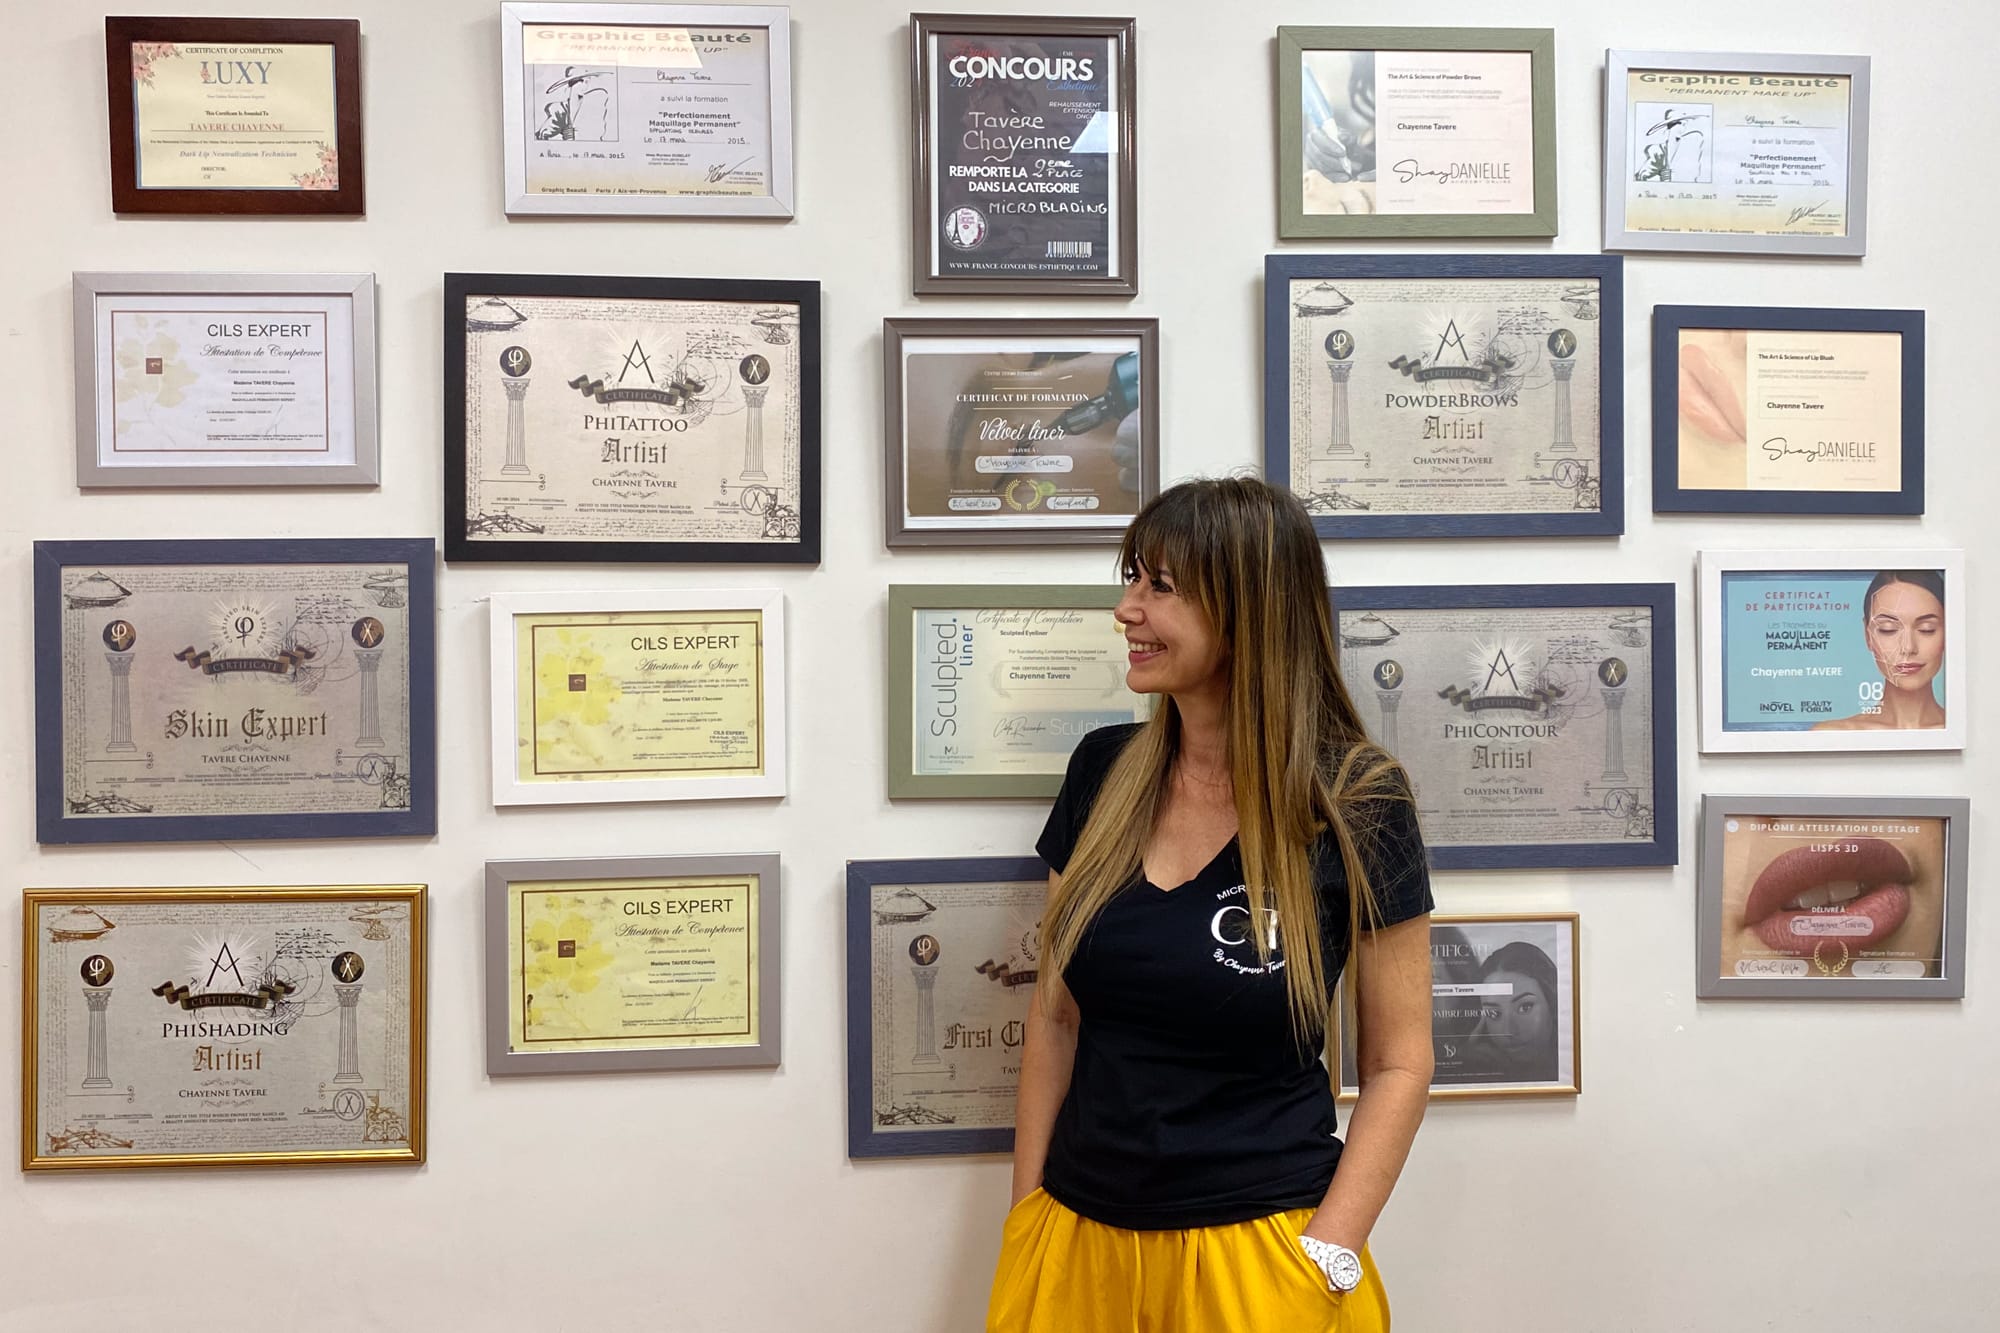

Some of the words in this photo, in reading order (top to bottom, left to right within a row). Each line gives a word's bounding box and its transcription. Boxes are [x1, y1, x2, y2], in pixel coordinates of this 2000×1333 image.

[536, 30, 645, 42] Graphic
[655, 33, 751, 43] Beauté
[201, 61, 272, 84] LUXY
[949, 56, 1094, 81] CONCOURS
[1639, 73, 1740, 86] Graphic
[1749, 74, 1839, 88] Beauté
[649, 120, 691, 128] Maquillage
[968, 108, 1045, 129] Tavère
[190, 123, 227, 131] TAVERE
[231, 123, 285, 131] CHAYENNE
[1397, 123, 1432, 131] Chayenne
[963, 130, 1073, 162] Chayenne
[949, 166, 1010, 178] REMPORTE
[1012, 166, 1027, 178] LA
[968, 181, 1000, 192] DANS
[1002, 182, 1017, 192] LA
[1018, 182, 1079, 193] CATEGORIE
[207, 324, 243, 337] CILS
[248, 324, 312, 337] EXPERT
[200, 344, 251, 356] Attestation
[254, 347, 264, 356] de
[604, 391, 671, 402] CERTIFICATE
[956, 394, 1014, 402] CERTIFICAT
[1032, 393, 1089, 401] FORMATION
[1767, 402, 1800, 411] Chayenne
[979, 417, 1025, 441] Velvet
[1028, 420, 1065, 441] liner
[1422, 415, 1484, 440] Artist
[601, 437, 668, 464] Artist
[1413, 456, 1460, 465] CHAYENNE
[1463, 456, 1494, 465] TAVERE
[592, 478, 642, 488] CHAYENNE
[644, 479, 677, 489] TAVERE
[976, 608, 1021, 630] Certificate
[1035, 609, 1083, 630] Completion
[1000, 630, 1025, 638] Sculpted
[1025, 630, 1048, 638] Eyeliner
[1766, 631, 1830, 640] MAQUILLAGE
[631, 637, 668, 651] CILS
[674, 636, 740, 650] EXPERT
[960, 624, 973, 666] liner
[1768, 642, 1828, 650] PERMANENT
[213, 662, 277, 672] CERTIFICATE
[635, 658, 689, 672] Attestation
[691, 661, 703, 670] de
[708, 658, 739, 673] Stage
[1751, 667, 1803, 679] Chayenne
[1806, 667, 1843, 676] TAVERE
[1859, 682, 1883, 700] 08
[1861, 706, 1881, 714] 2023
[164, 709, 228, 739] Skin
[241, 707, 329, 744] Expert
[201, 754, 237, 763] TAVERE
[239, 753, 291, 763] CHAYENNE
[1472, 745, 1532, 769] Artist
[1464, 787, 1510, 795] CHAYENNE
[1799, 823, 1868, 833] ATTESTATION
[1872, 825, 1884, 833] DE
[1888, 825, 1920, 834] STAGE
[1811, 844, 1841, 853] LISPS
[1844, 845, 1859, 853] 3D
[623, 902, 661, 915] CILS
[666, 899, 733, 914] EXPERT
[615, 923, 669, 937] Attestation
[671, 927, 683, 936] de
[1224, 958, 1264, 974] Chayenne
[1465, 1009, 1497, 1017] BROWS
[943, 1022, 992, 1050] First
[192, 1044, 262, 1072] Artist
[179, 1089, 231, 1098] CHAYENNE
[233, 1089, 268, 1098] TAVERE
